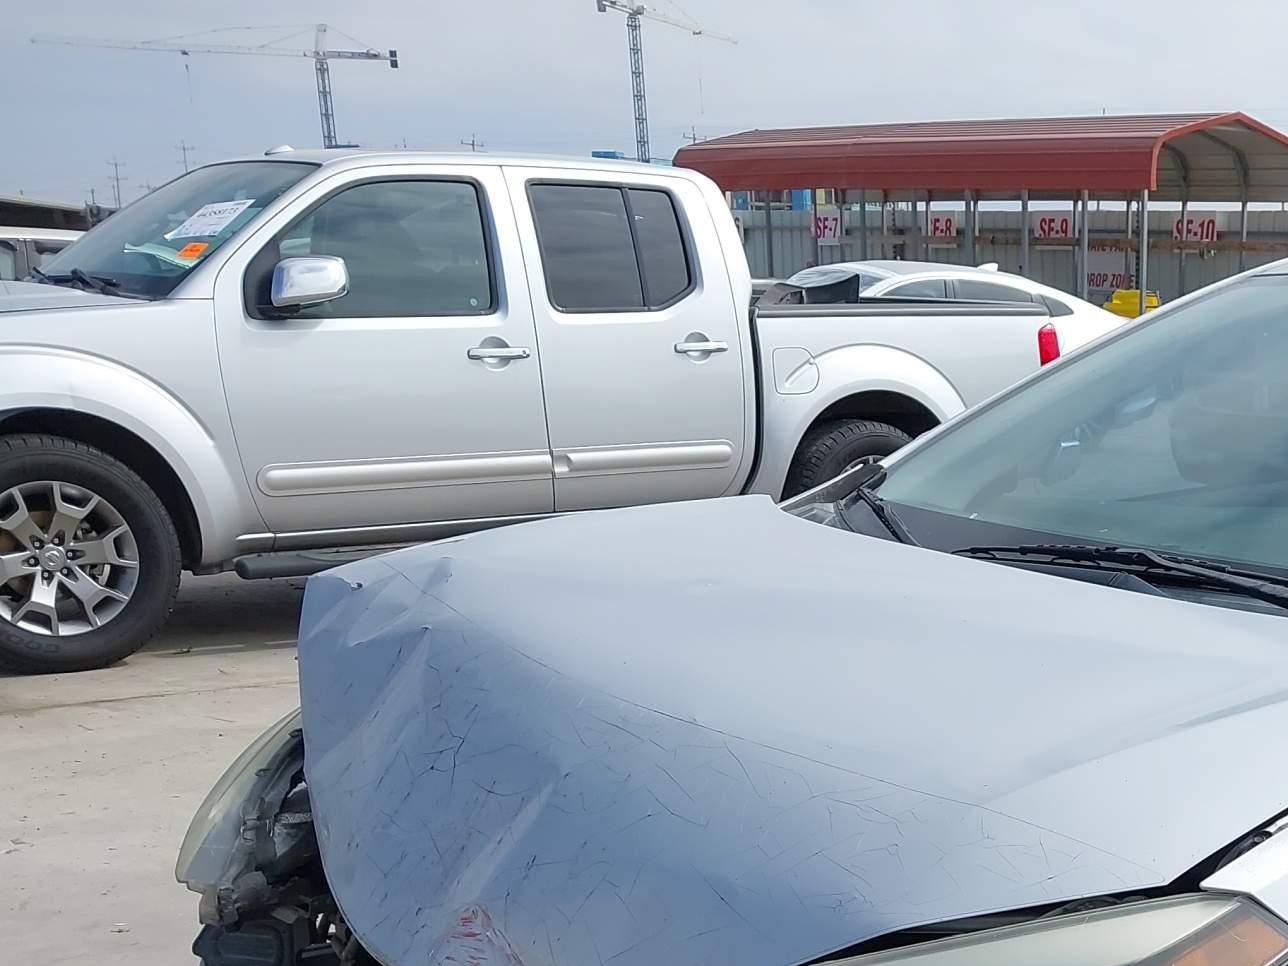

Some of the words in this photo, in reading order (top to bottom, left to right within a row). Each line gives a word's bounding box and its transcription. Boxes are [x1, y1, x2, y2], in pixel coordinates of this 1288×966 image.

[816, 217, 838, 239] SF-7
[930, 218, 952, 237] F-8
[1039, 218, 1068, 238] SF-9
[1174, 218, 1216, 241] SF-10
[1087, 272, 1109, 288] ROP
[1109, 273, 1136, 289] ZOE
